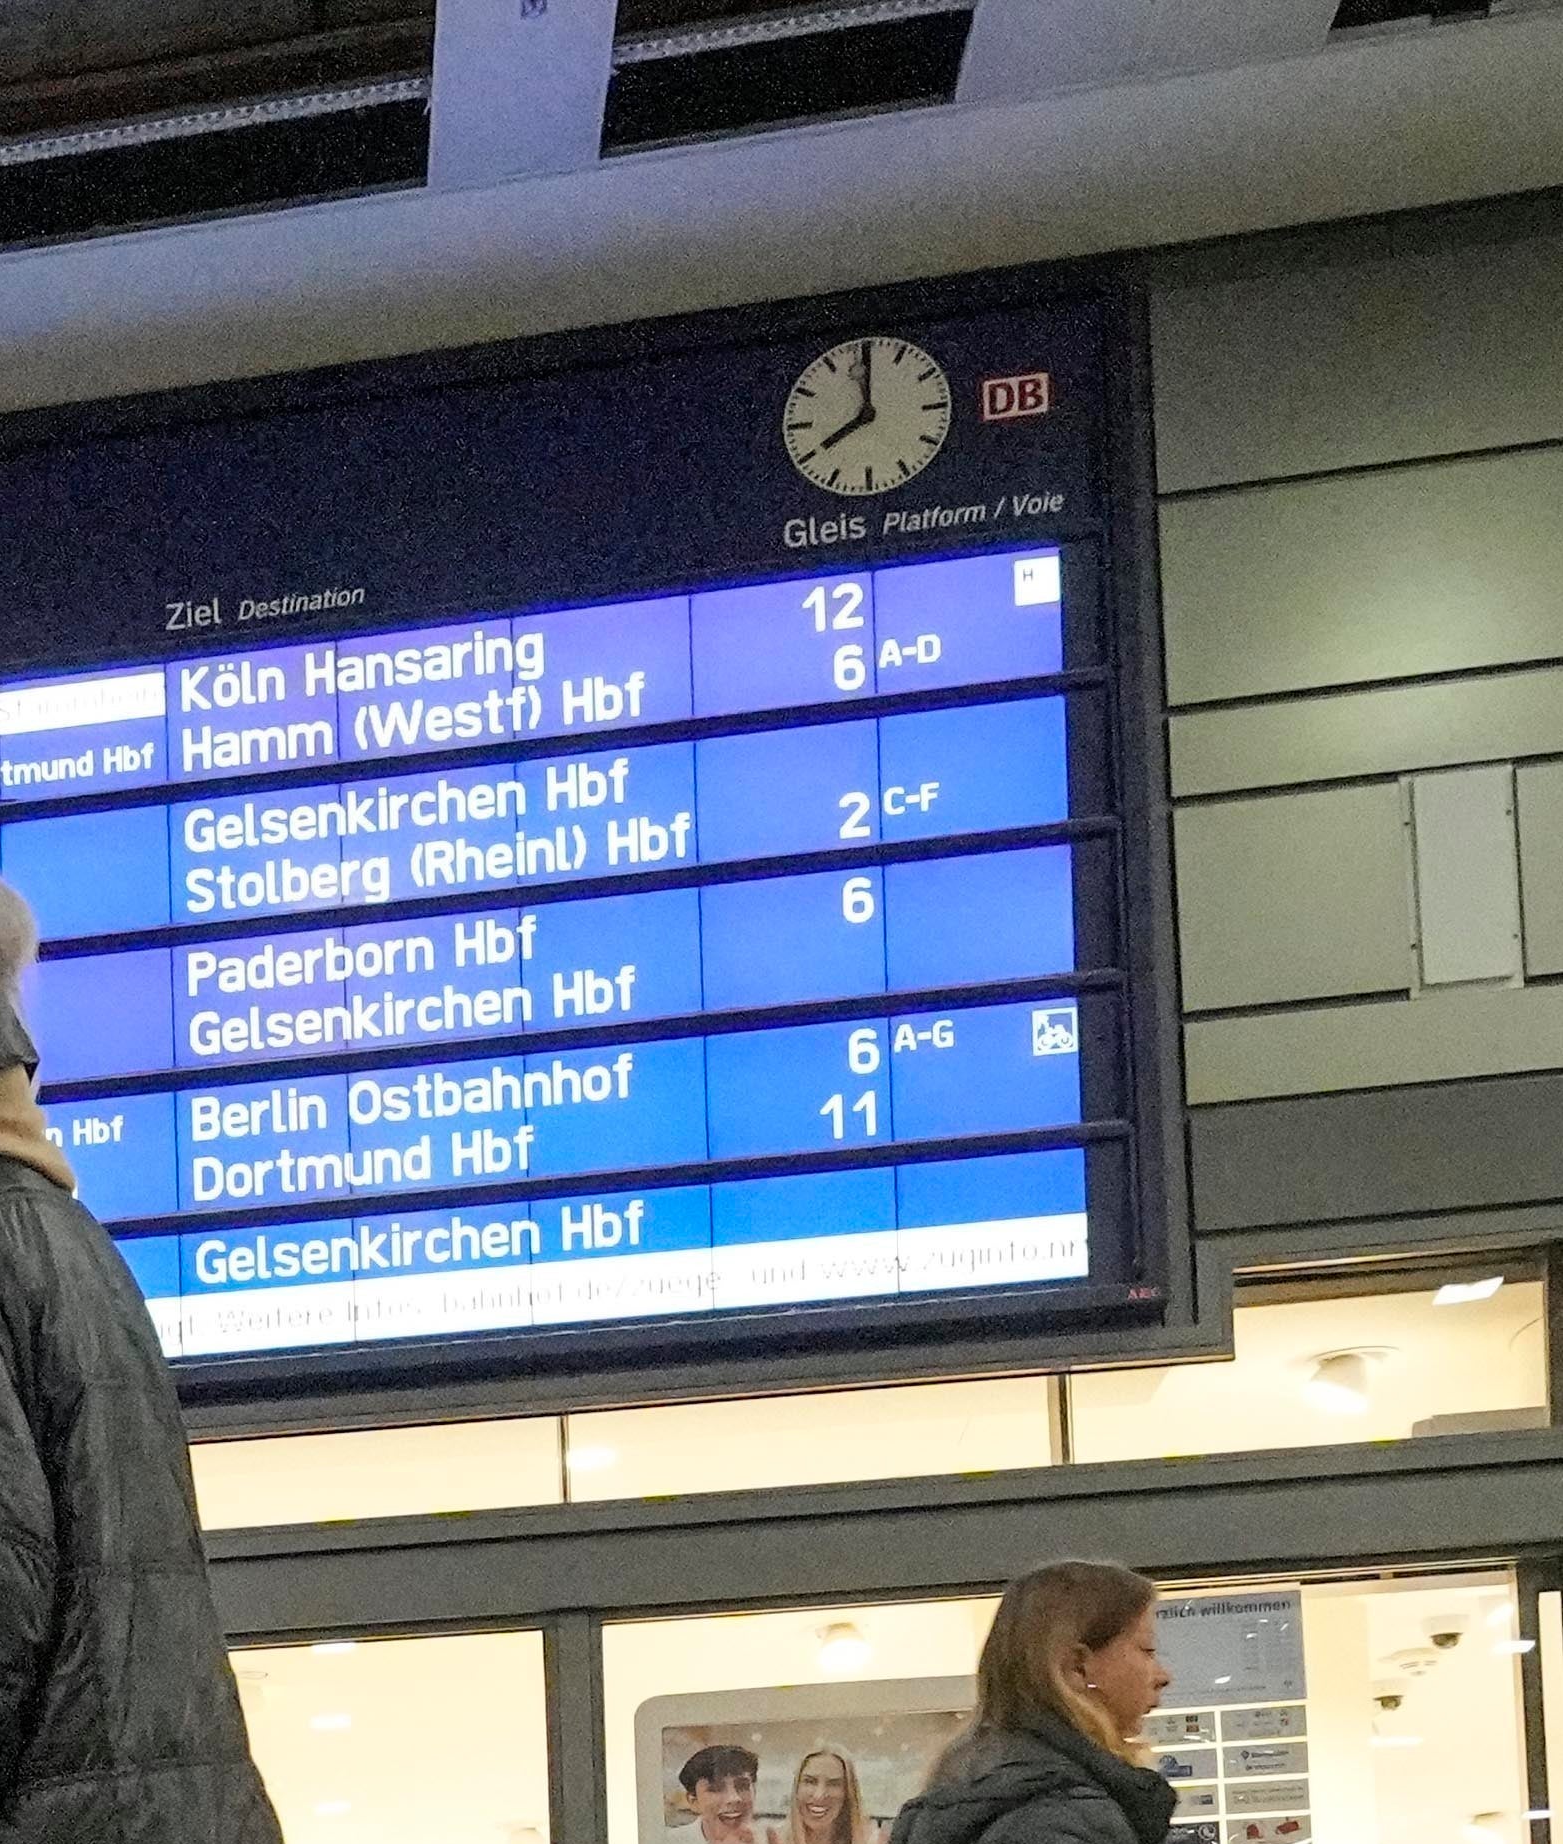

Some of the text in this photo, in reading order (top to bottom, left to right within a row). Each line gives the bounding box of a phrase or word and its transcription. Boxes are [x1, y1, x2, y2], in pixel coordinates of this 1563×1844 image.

[988, 377, 1045, 415] DB
[784, 514, 866, 549] Gleis
[883, 491, 1065, 534] Platform / Voie
[165, 599, 222, 631] Ziel
[238, 586, 365, 621] Destination
[802, 582, 864, 632] 12
[180, 663, 285, 713] Köln
[305, 630, 545, 697] Hansaring
[833, 643, 865, 691] 6
[879, 633, 942, 669] A-D
[182, 671, 644, 772] Hamm (Westf) Hbf
[102, 743, 155, 774] Hbf
[184, 758, 629, 854] Gelsenkirchen Hbf
[838, 791, 871, 840] 2
[883, 781, 940, 815] C-F
[185, 813, 691, 914] Stolberg (Rheinl) Hbf
[842, 877, 874, 923] 6
[188, 915, 537, 997] Paderborn Hbf
[188, 965, 636, 1056] Gelsenkirchen Hbf
[847, 1028, 880, 1074] 6
[894, 1019, 954, 1053] A-G
[191, 1053, 634, 1142] Berlin Ostbahnhof
[819, 1090, 877, 1140] 11
[73, 1115, 123, 1146] Hbf
[192, 1125, 535, 1201] Dortmund Hbf
[194, 1199, 644, 1284] Gelsenkirchen Hbf
